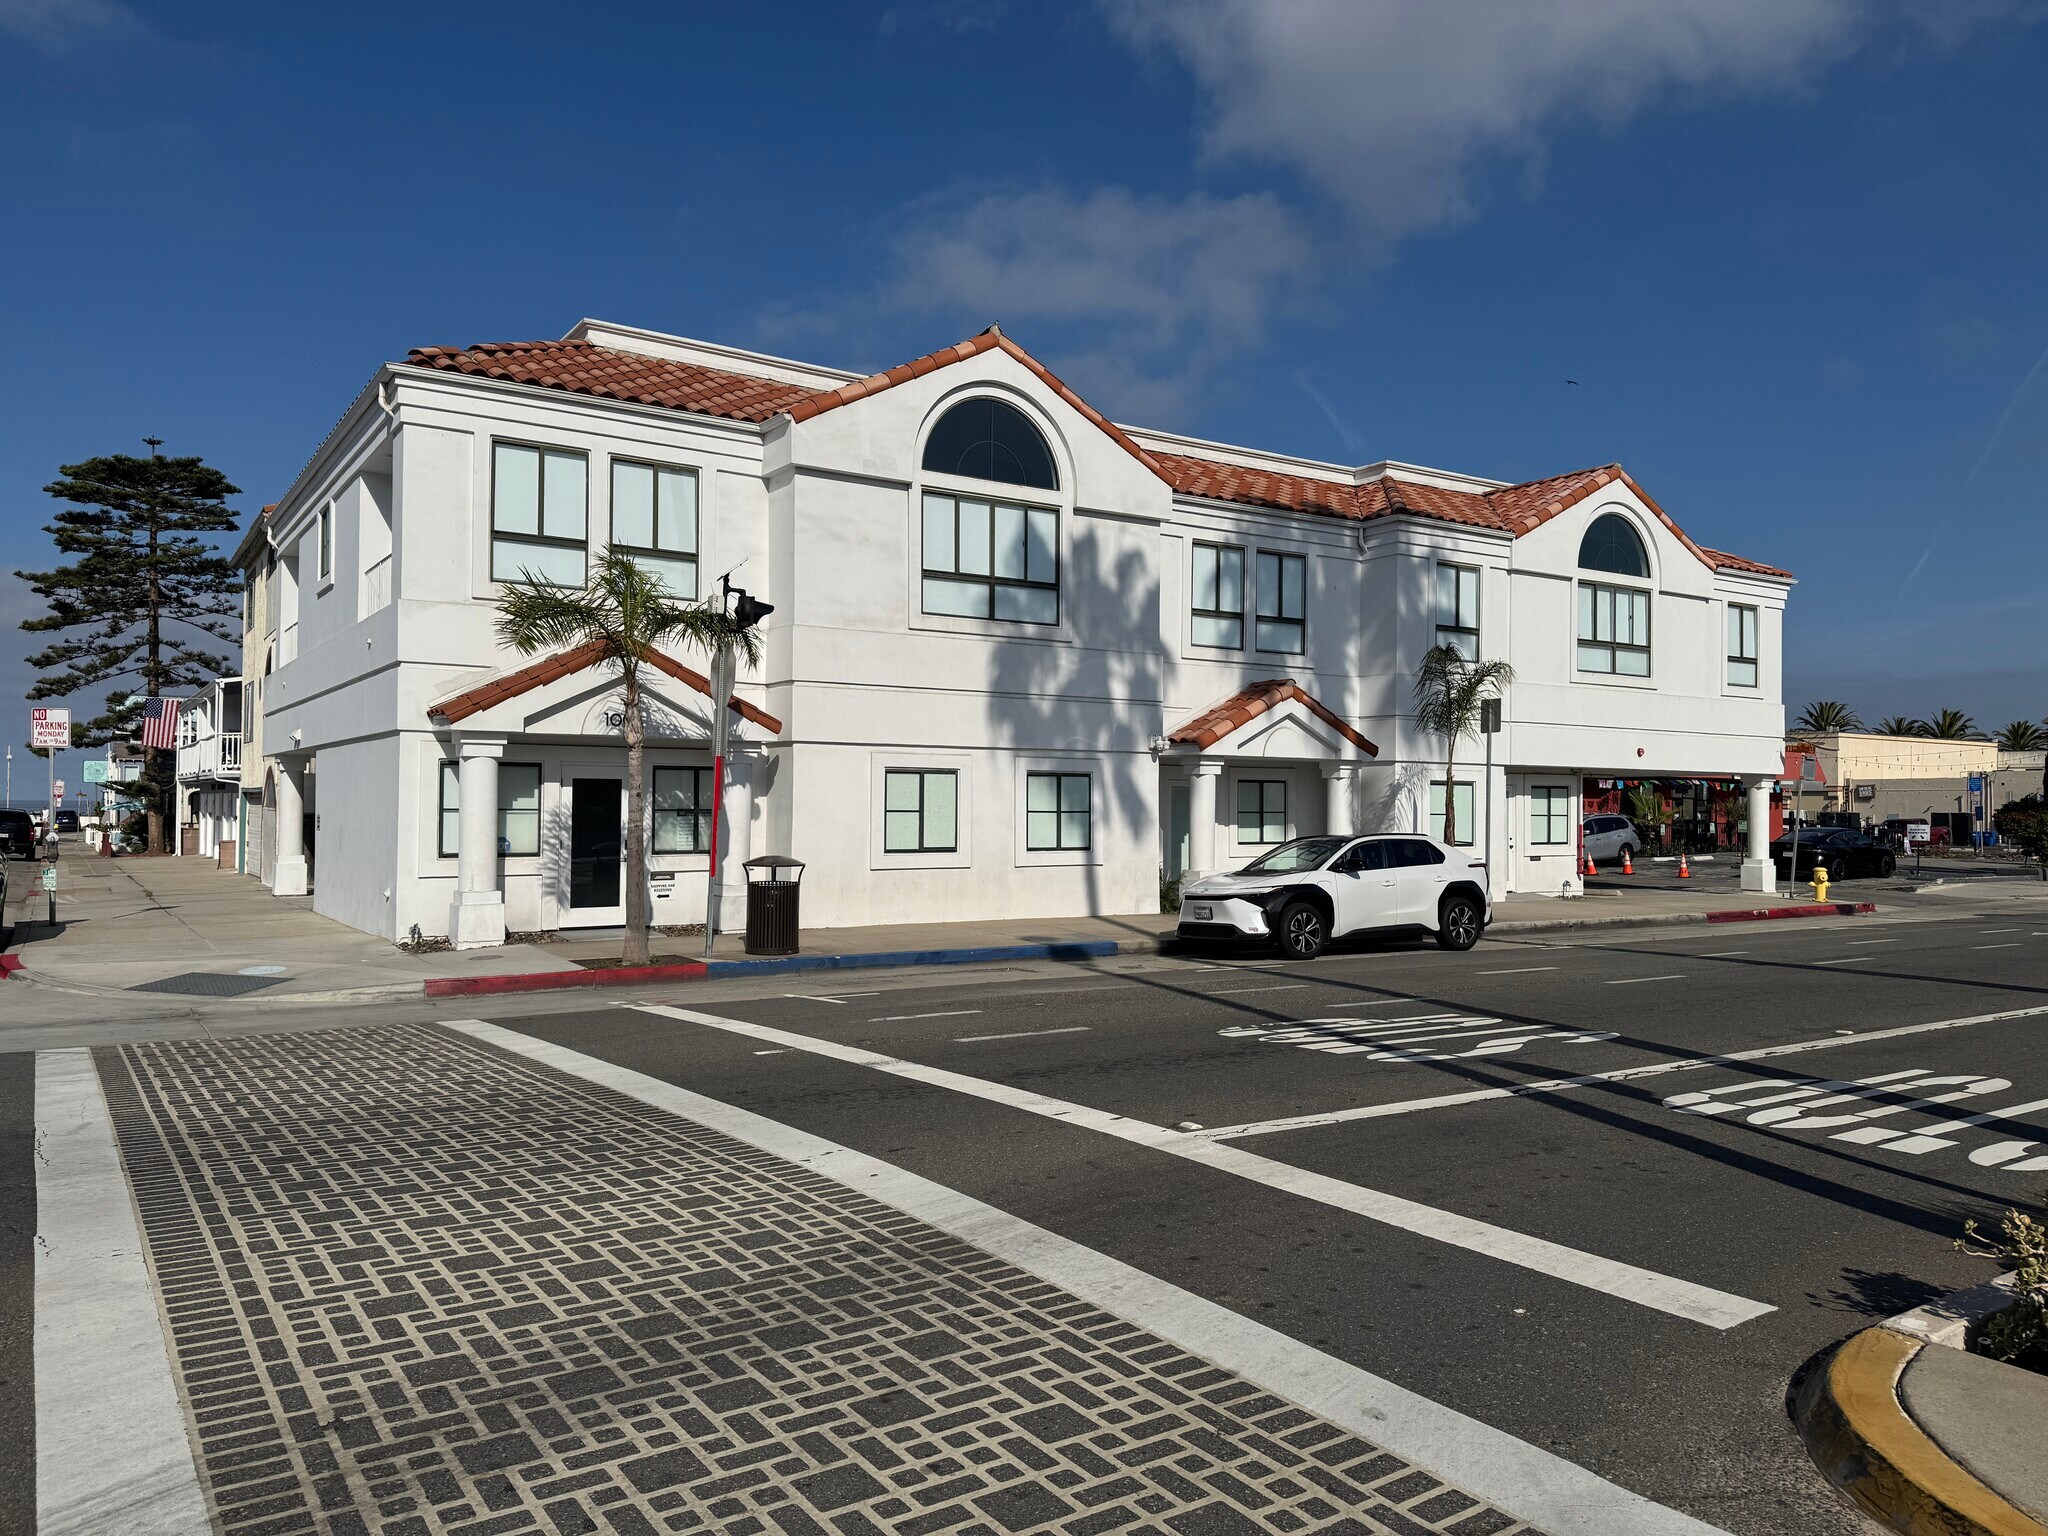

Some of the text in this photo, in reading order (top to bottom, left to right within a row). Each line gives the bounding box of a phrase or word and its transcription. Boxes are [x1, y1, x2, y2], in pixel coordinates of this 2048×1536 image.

[34, 710, 45, 719] NO
[35, 721, 67, 730] PARKING
[1218, 1014, 1620, 1062] STOP
[1662, 1069, 2048, 1171] TOP
